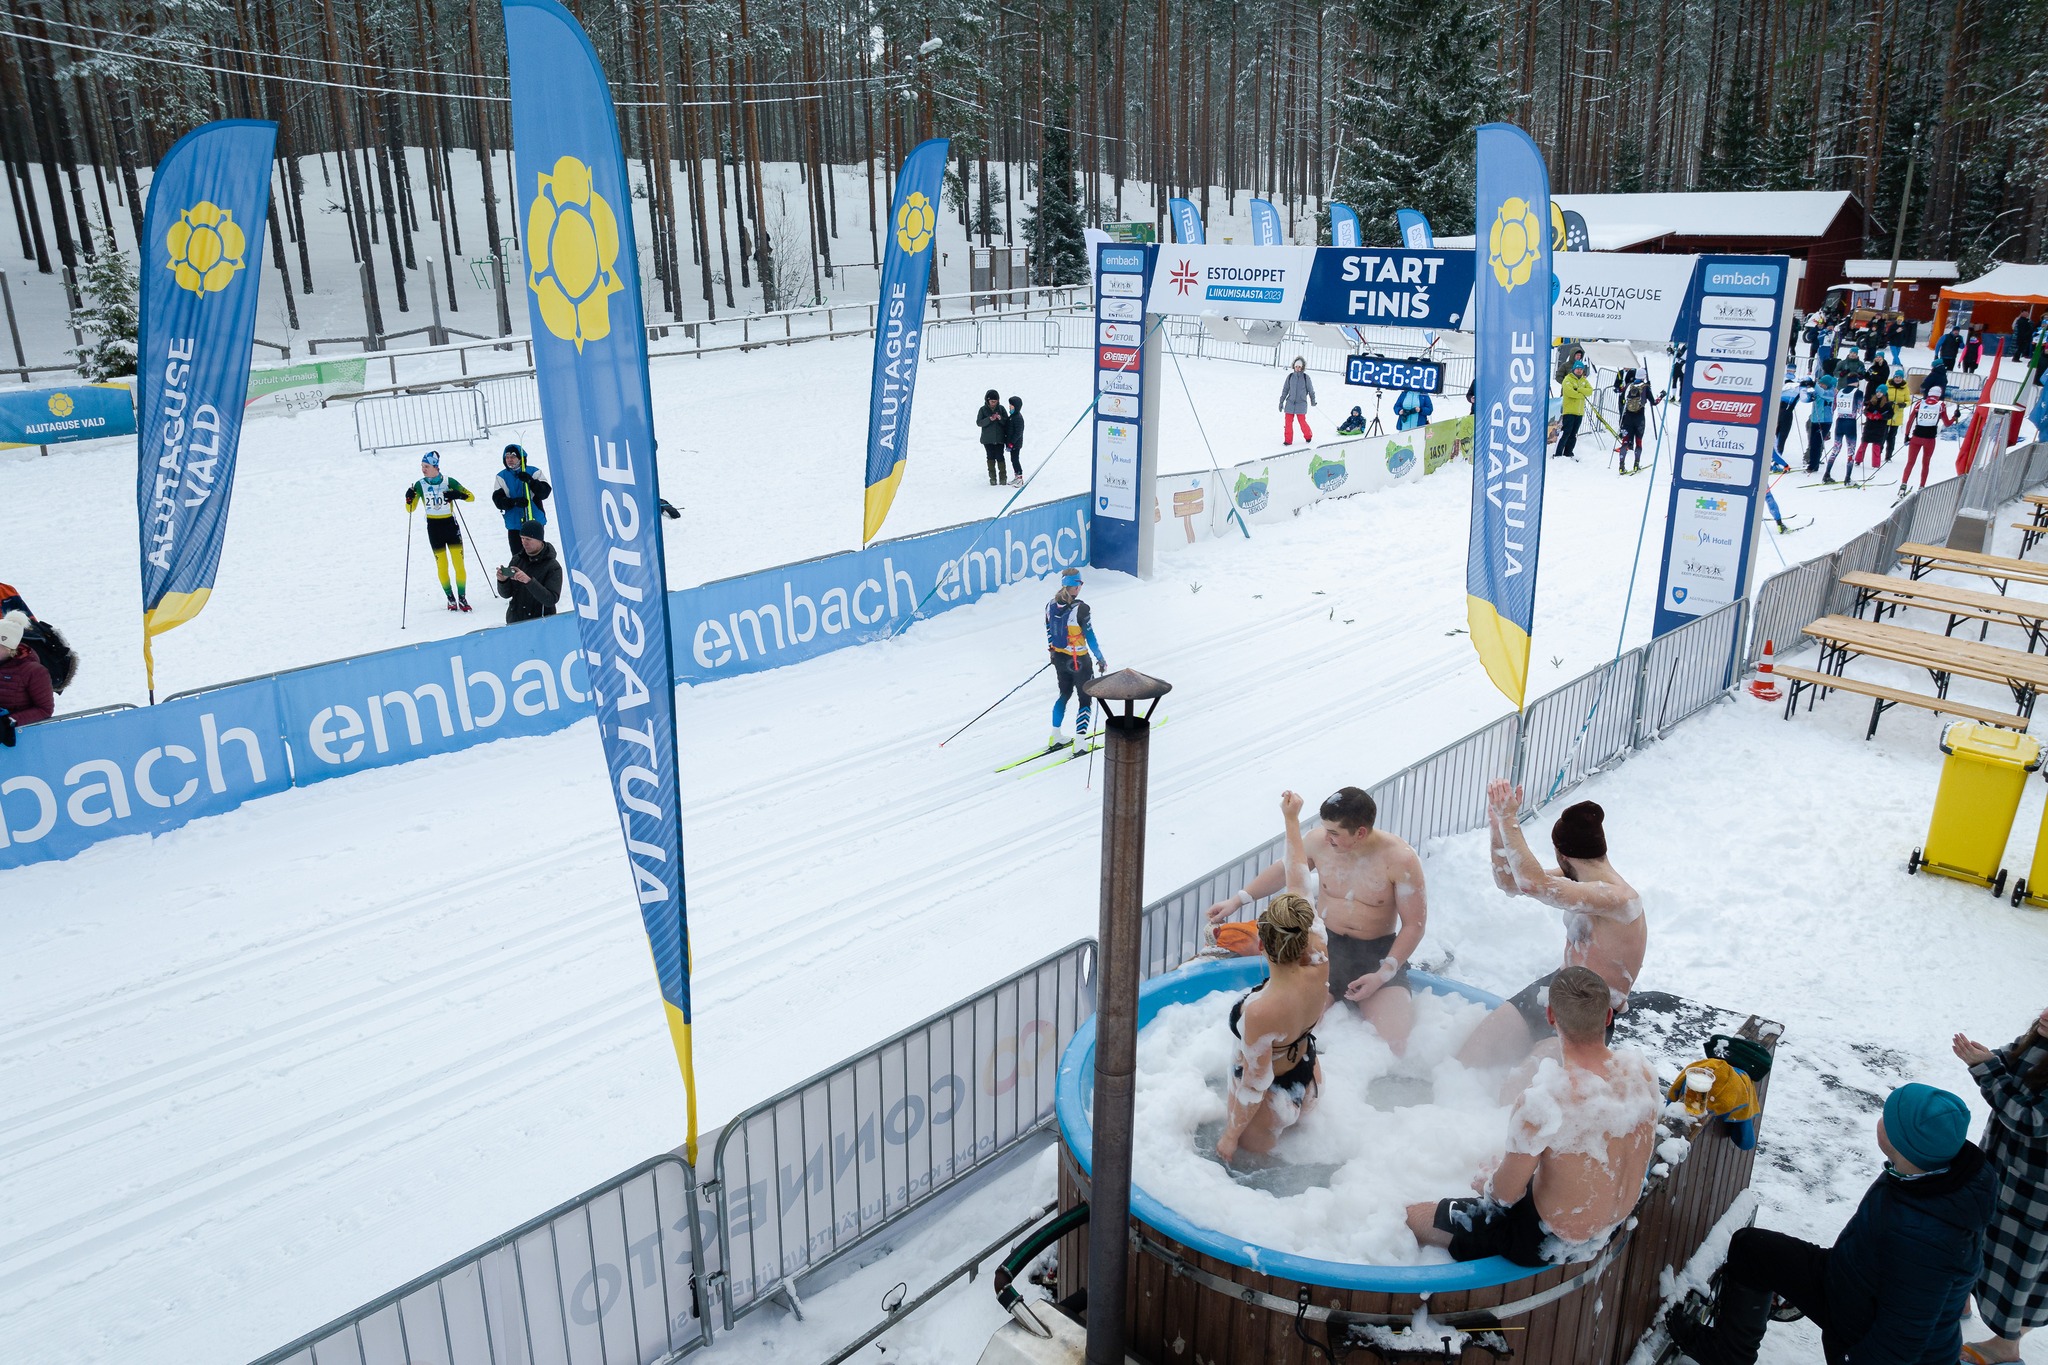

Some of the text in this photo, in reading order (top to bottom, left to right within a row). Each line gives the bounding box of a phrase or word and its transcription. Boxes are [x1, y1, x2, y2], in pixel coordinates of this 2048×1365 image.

[1106, 256, 1139, 266] embach
[1207, 267, 1286, 283] ESTOLOPPET
[1341, 255, 1445, 285] START
[1712, 272, 1770, 286] embach
[1208, 287, 1282, 302] LIIKUMISAASTA 2023
[1564, 284, 1662, 301] 45. ALUTAGUSE
[1348, 285, 1431, 320] FINIŠ
[1561, 297, 1626, 311] MARATON
[1112, 333, 1135, 342] JETOIL
[1710, 348, 1755, 356] ESTMARE
[880, 283, 907, 450] ALUTAGUSE
[1350, 360, 1437, 390] 02:26:20
[1715, 376, 1754, 387] JETOIL
[295, 389, 323, 401] 10-20
[286, 402, 293, 412] P
[1711, 400, 1757, 413] ENERVIT
[1919, 412, 1938, 420] 2057
[25, 416, 106, 434] ALUTAGUSE VALD
[1698, 436, 1745, 451] Vytautas
[149, 337, 195, 571] ALUTAGUSE
[185, 403, 221, 508] VALD
[1712, 536, 1733, 546] Hotell
[692, 556, 918, 669] embach
[308, 654, 597, 765] embac
